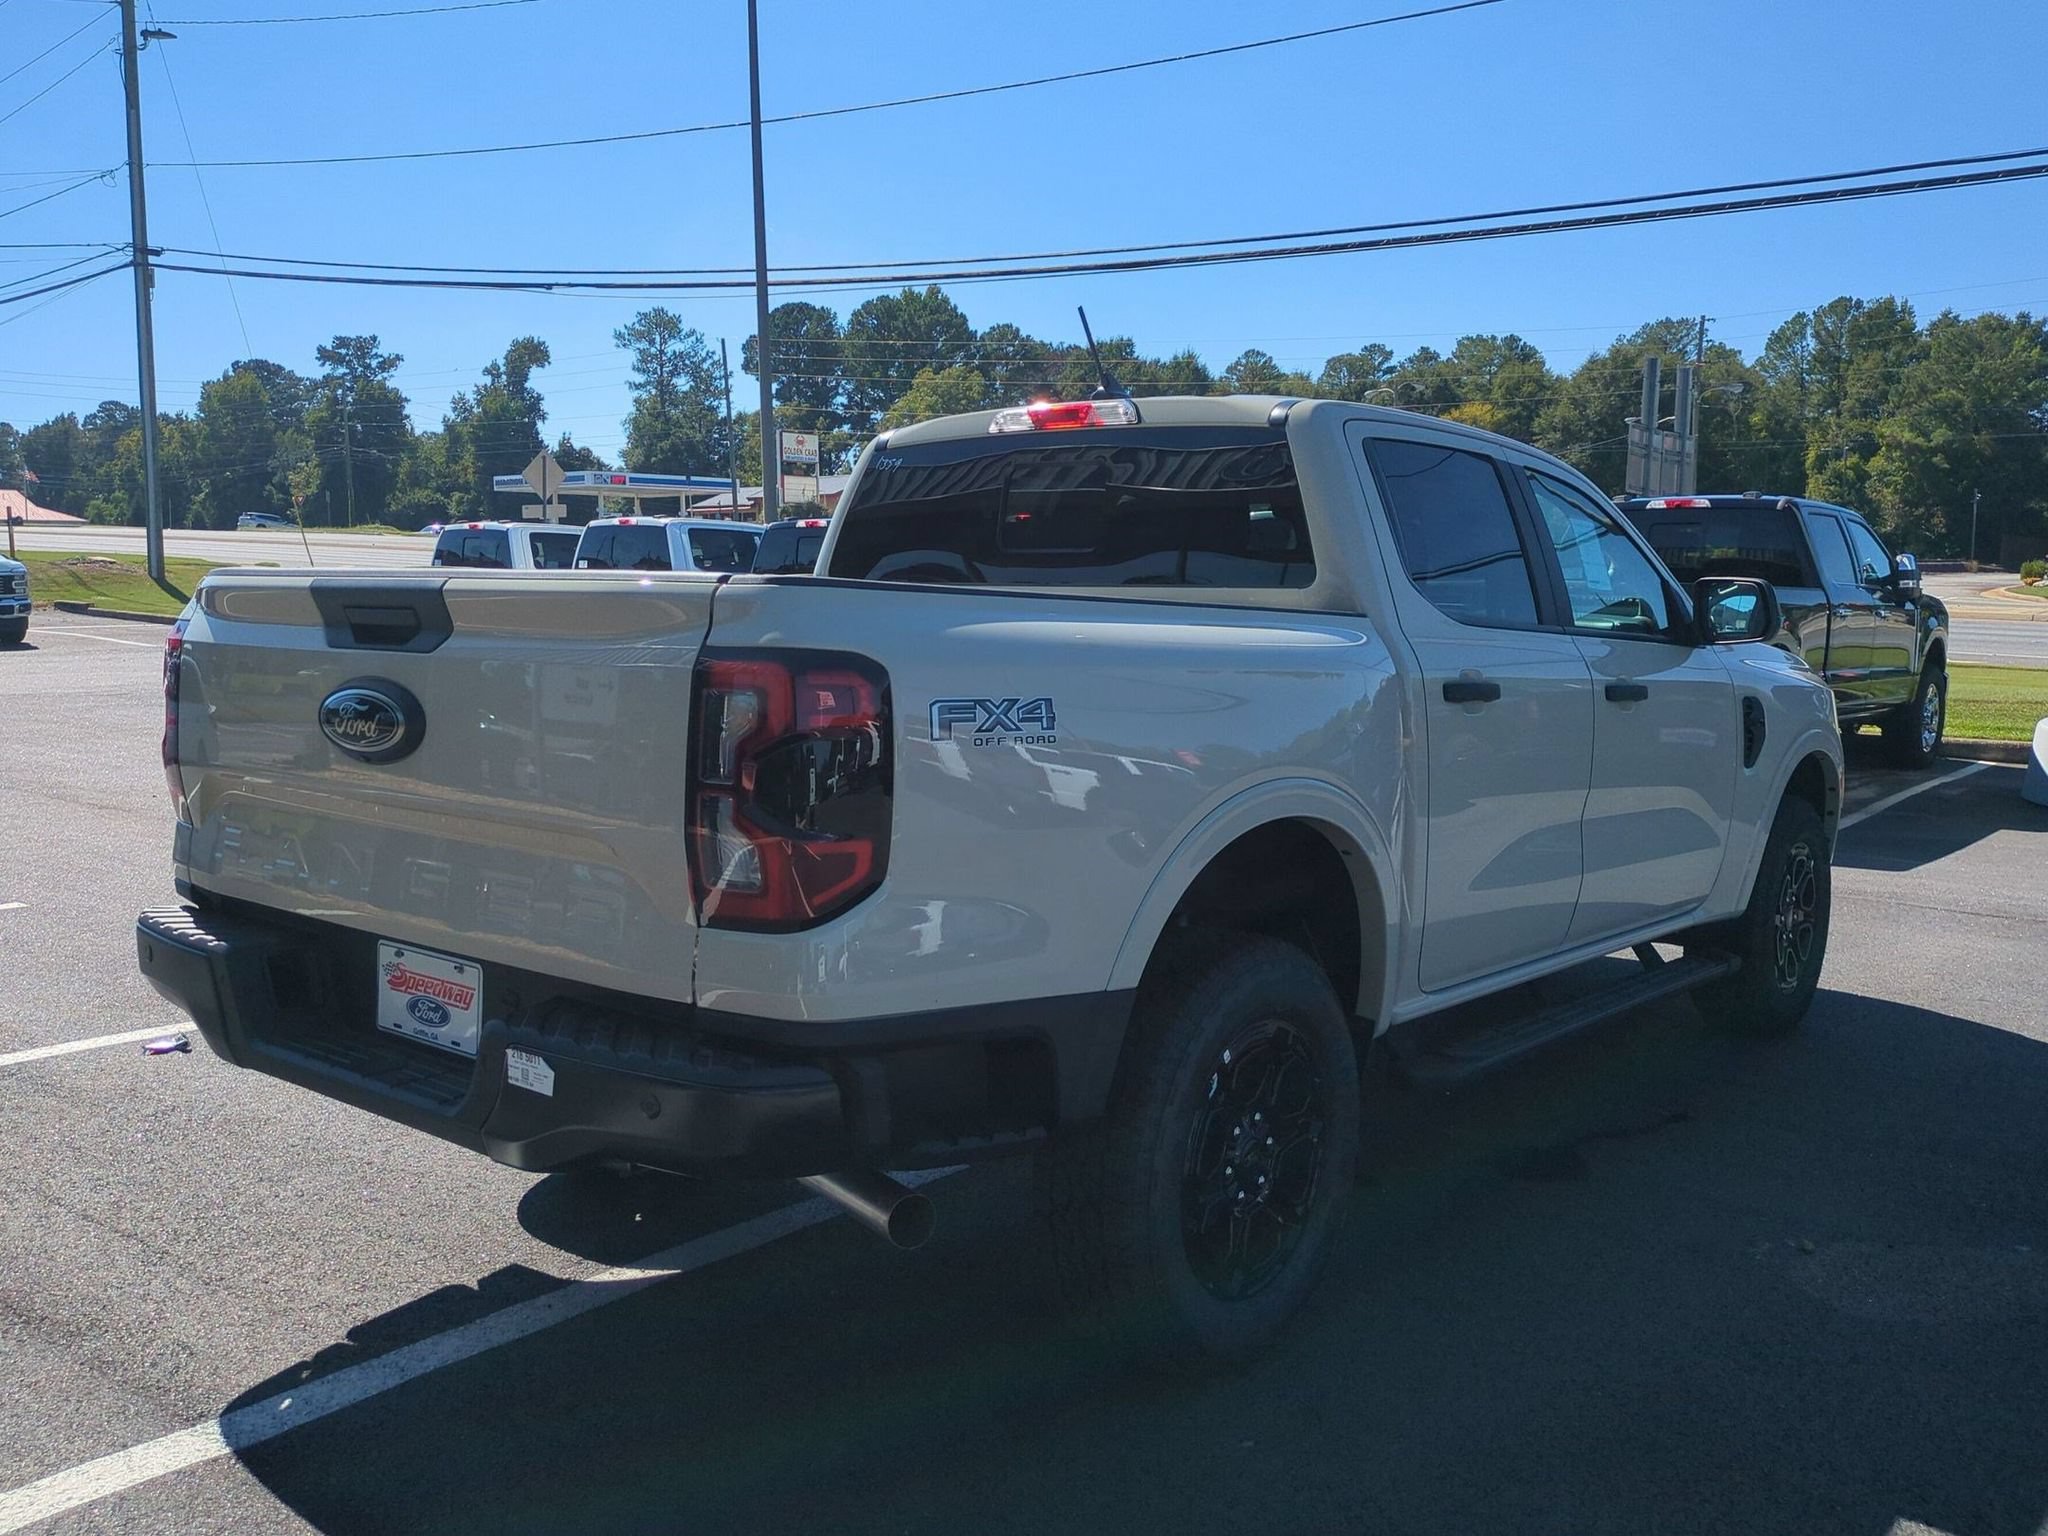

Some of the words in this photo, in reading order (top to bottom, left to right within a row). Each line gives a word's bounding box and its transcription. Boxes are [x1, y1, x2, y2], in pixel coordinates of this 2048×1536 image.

[784, 447, 803, 456] GOLDEN
[805, 448, 817, 457] CRAB
[335, 701, 380, 737] Ford
[928, 697, 1057, 742] FX4
[973, 736, 1007, 747] OFF
[1014, 734, 1057, 745] ROAD
[387, 962, 476, 1011] Speedway
[414, 999, 442, 1023] Ford
